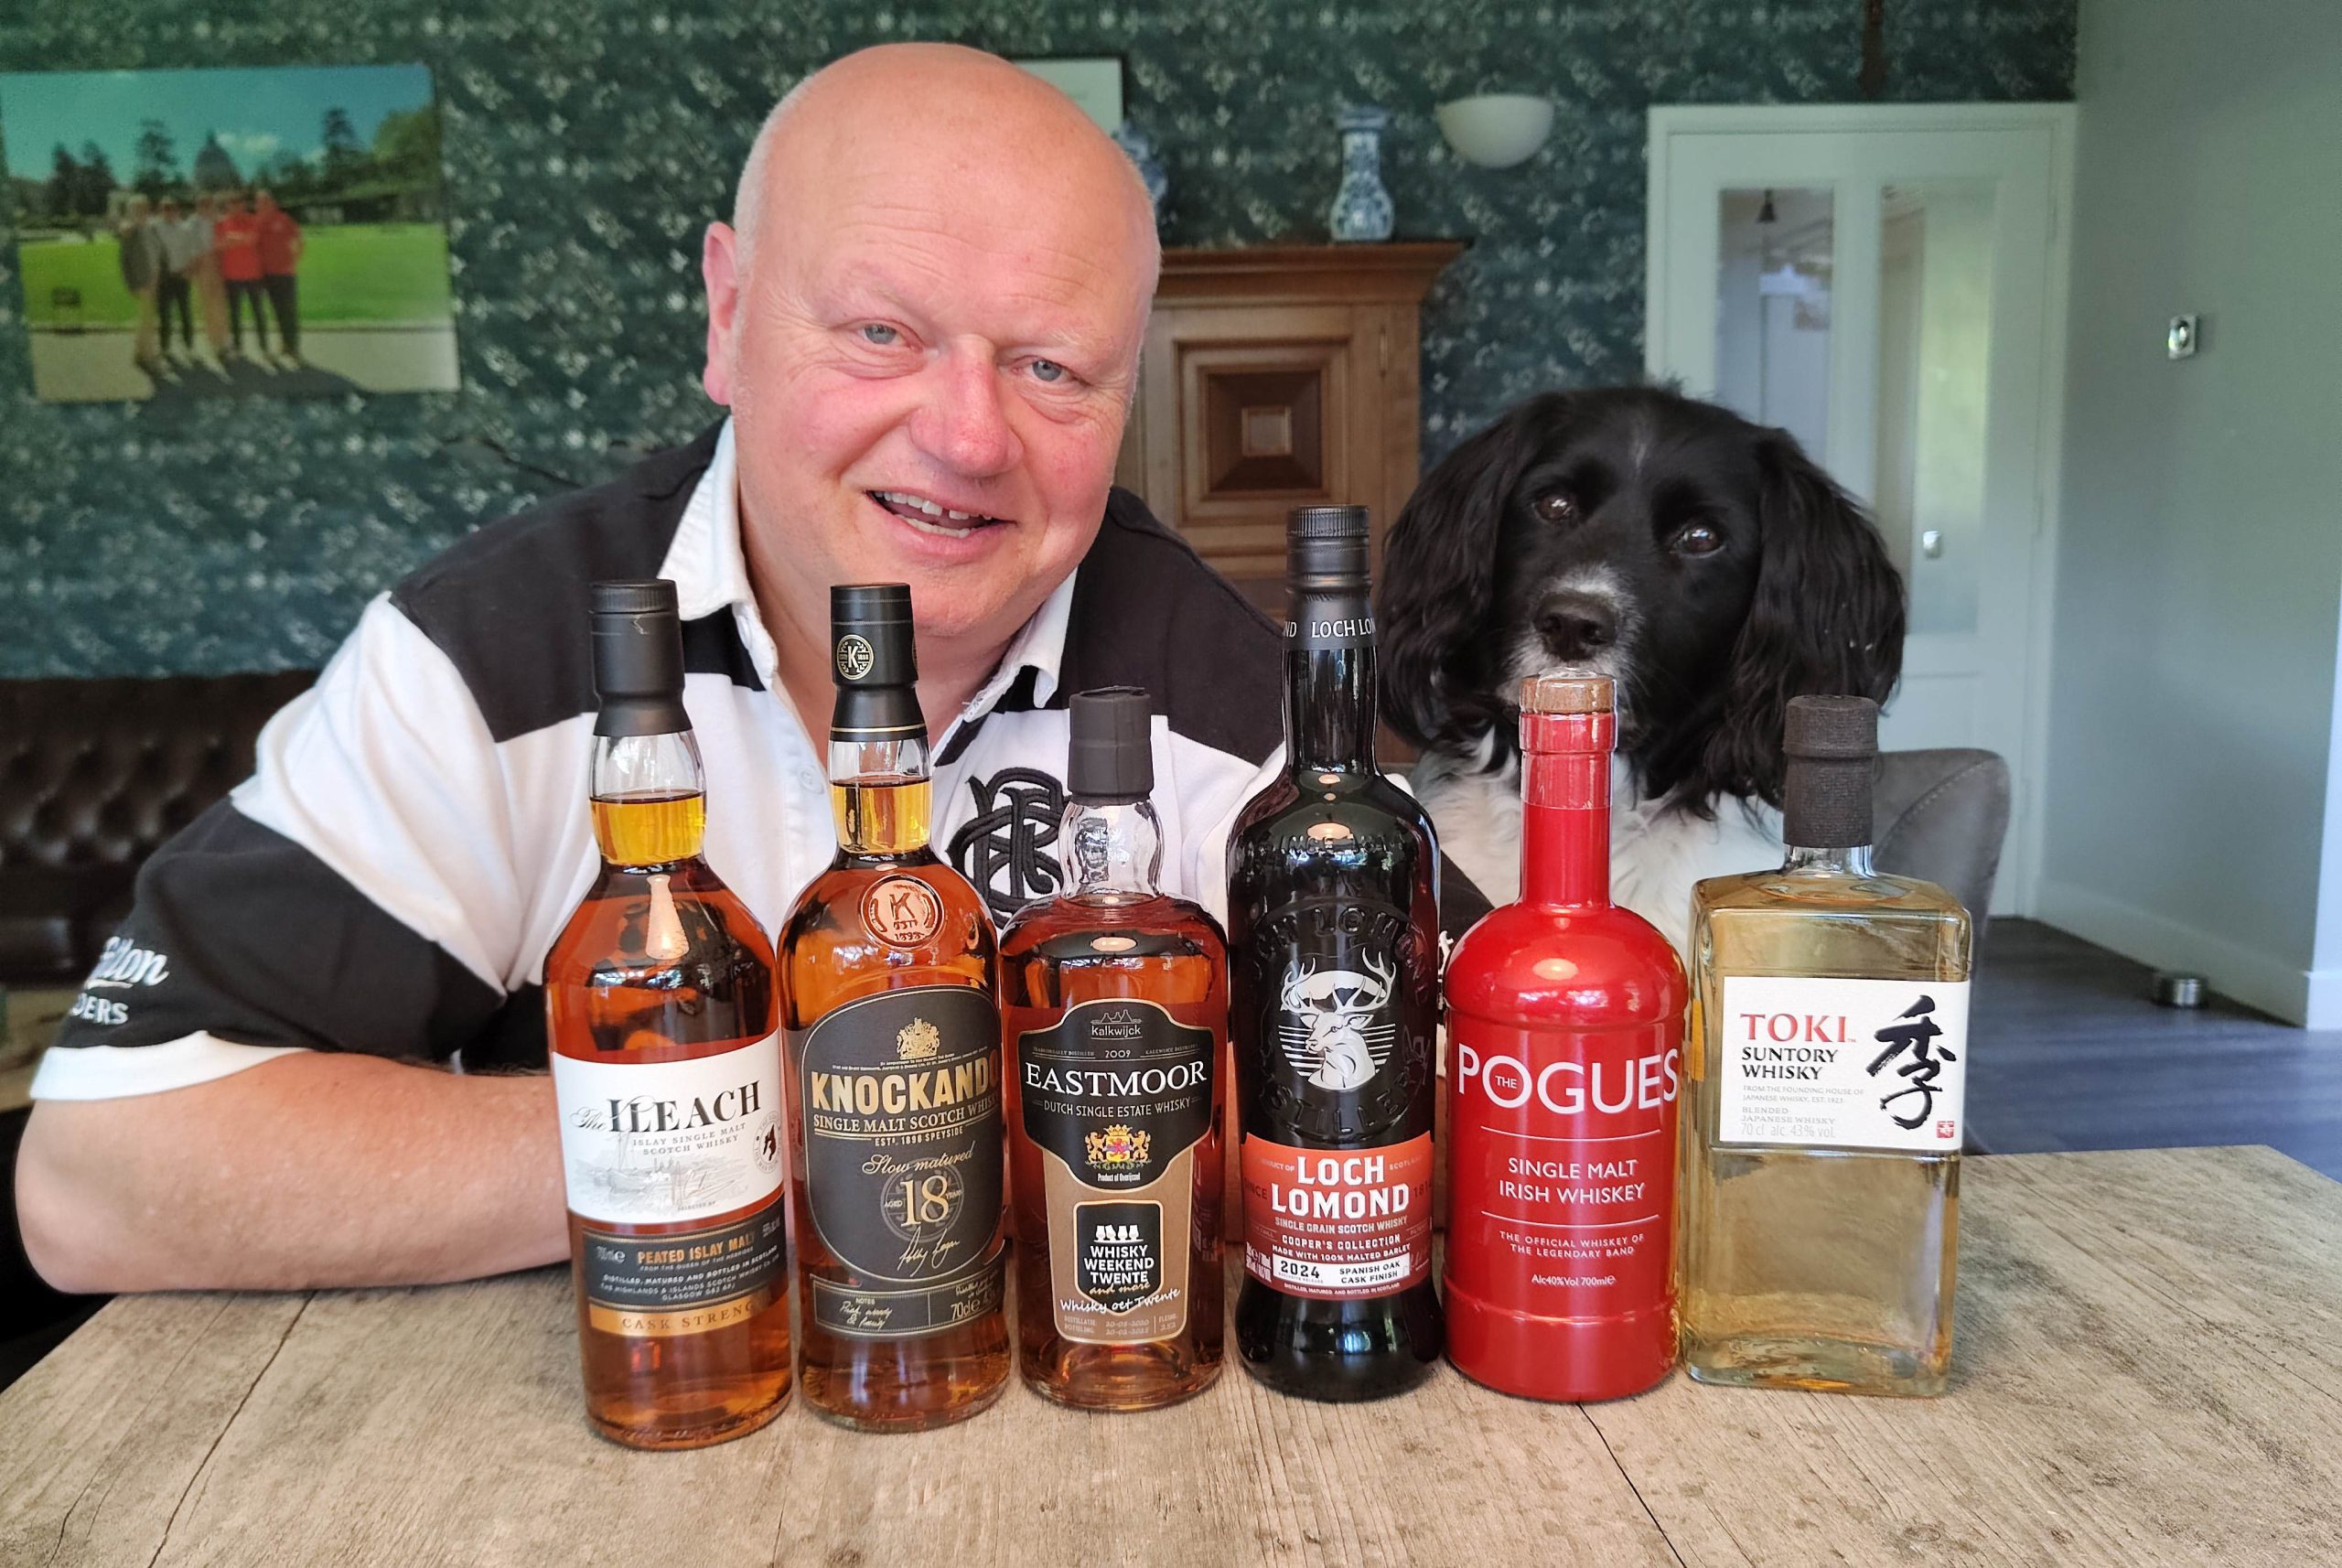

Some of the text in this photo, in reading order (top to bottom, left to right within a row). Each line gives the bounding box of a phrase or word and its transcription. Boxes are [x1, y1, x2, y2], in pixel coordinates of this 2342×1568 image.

[1311, 619, 1356, 639] LOCH
[1740, 1013, 1847, 1043] TOKI
[1104, 1049, 1131, 1058] 2009
[1742, 1047, 1839, 1064] SUNTORY
[1025, 1060, 1207, 1098] EASTMOOR
[1458, 1042, 1678, 1114] POGUES
[1742, 1064, 1823, 1079] WHISKY
[811, 1048, 1001, 1115] KNOCKANDO
[1494, 1075, 1518, 1090] THE
[1782, 1086, 1823, 1094] FOUNDING
[607, 1079, 761, 1133] ILEACH
[1044, 1096, 1191, 1118] DUTCH SINGLE ESTATE WHISKY
[1742, 1106, 1789, 1114] BLENDED
[813, 1114, 861, 1133] SINGLE
[864, 1118, 907, 1133] MALT
[909, 1108, 965, 1130] SCOTCH
[1741, 1115, 1793, 1123] JAPANESE
[632, 1122, 747, 1147] ISLAY SINGLE MALT
[901, 1133, 924, 1145] 1898
[925, 1126, 964, 1143] SPEYSIDE
[642, 1134, 739, 1155] SCOTCH WHISKY
[862, 1140, 976, 1175] Slow matured
[1097, 1173, 1114, 1182] Product
[1296, 1155, 1385, 1187] LOCH
[1508, 1157, 1638, 1179] SINGLE MALT
[1271, 1182, 1410, 1219] LOMOND
[1499, 1179, 1646, 1204] IRISH WHISKEY
[900, 1175, 950, 1228] 18
[1274, 1216, 1305, 1232] SINGLE
[1306, 1220, 1336, 1234] GRAIN
[1338, 1223, 1375, 1234] SCOTCH
[1376, 1214, 1408, 1231] WHISKY
[1282, 1233, 1402, 1251] COOPER'S COLLECTION
[1499, 1230, 1645, 1248] THE OFFICIAL WHISKEY OF
[638, 1249, 685, 1265] PEATED
[689, 1241, 725, 1261] ISLAY
[1090, 1245, 1148, 1258] WHISKY
[1273, 1242, 1412, 1262] MADE WITH 100% MALTED BARLEY
[1510, 1243, 1635, 1259] THE LEGENDARY BAND
[686, 1273, 704, 1282] AND
[705, 1263, 741, 1279] BOTTLED
[1083, 1257, 1155, 1271] WEEKEND
[1280, 1260, 1321, 1279] 2024
[1339, 1260, 1401, 1275] SPANISH OAK
[1090, 1271, 1148, 1284] TWENTE
[1341, 1270, 1399, 1284] CASK FINISH
[661, 1290, 704, 1302] GLASGOW
[670, 1283, 705, 1294] ISLANDS
[1089, 1281, 1151, 1295] and more
[1059, 1287, 1181, 1314] Whisky oet Twente
[622, 1316, 671, 1329] CASK
